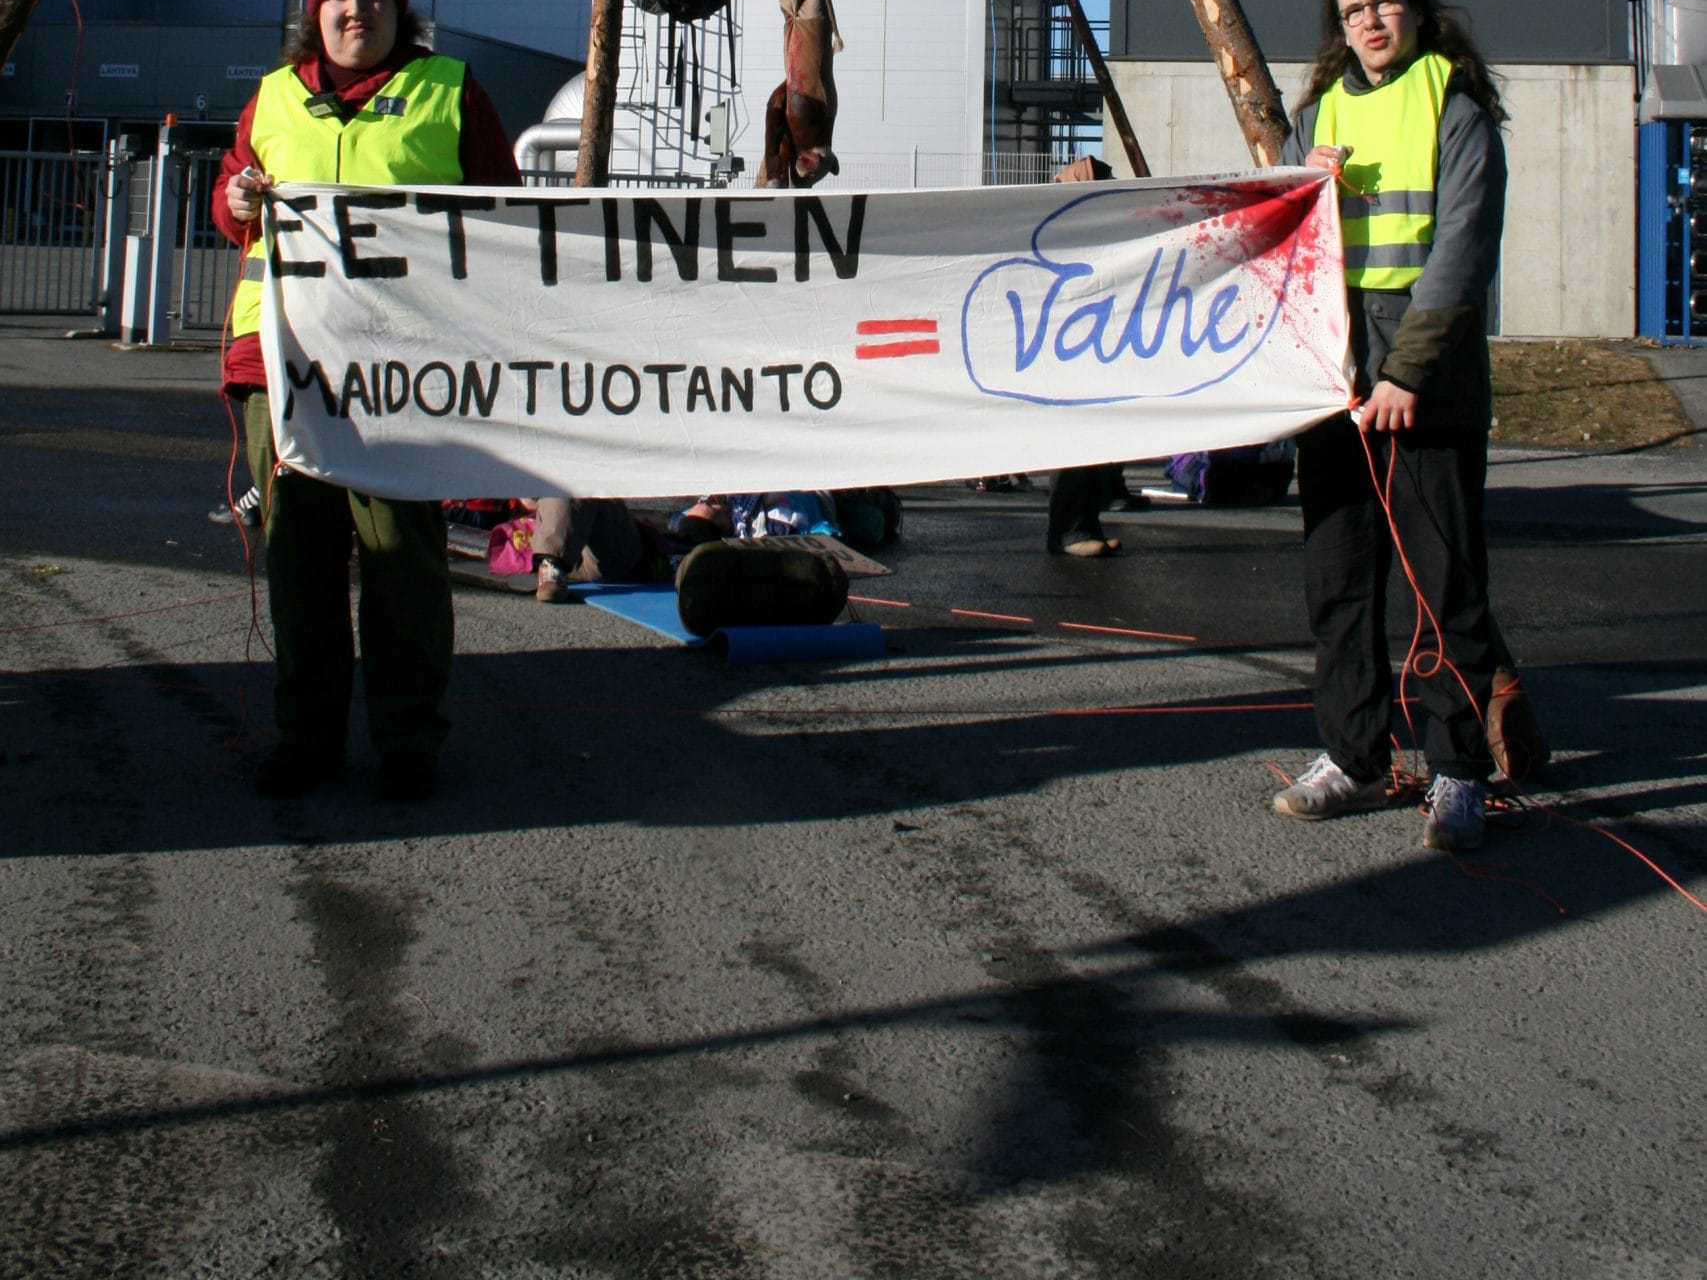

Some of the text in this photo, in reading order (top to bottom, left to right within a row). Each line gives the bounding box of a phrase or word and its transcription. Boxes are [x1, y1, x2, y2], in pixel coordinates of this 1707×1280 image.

[196, 94, 207, 109] 6
[265, 193, 867, 286] EETTINEN
[1006, 246, 1251, 373] Valhe
